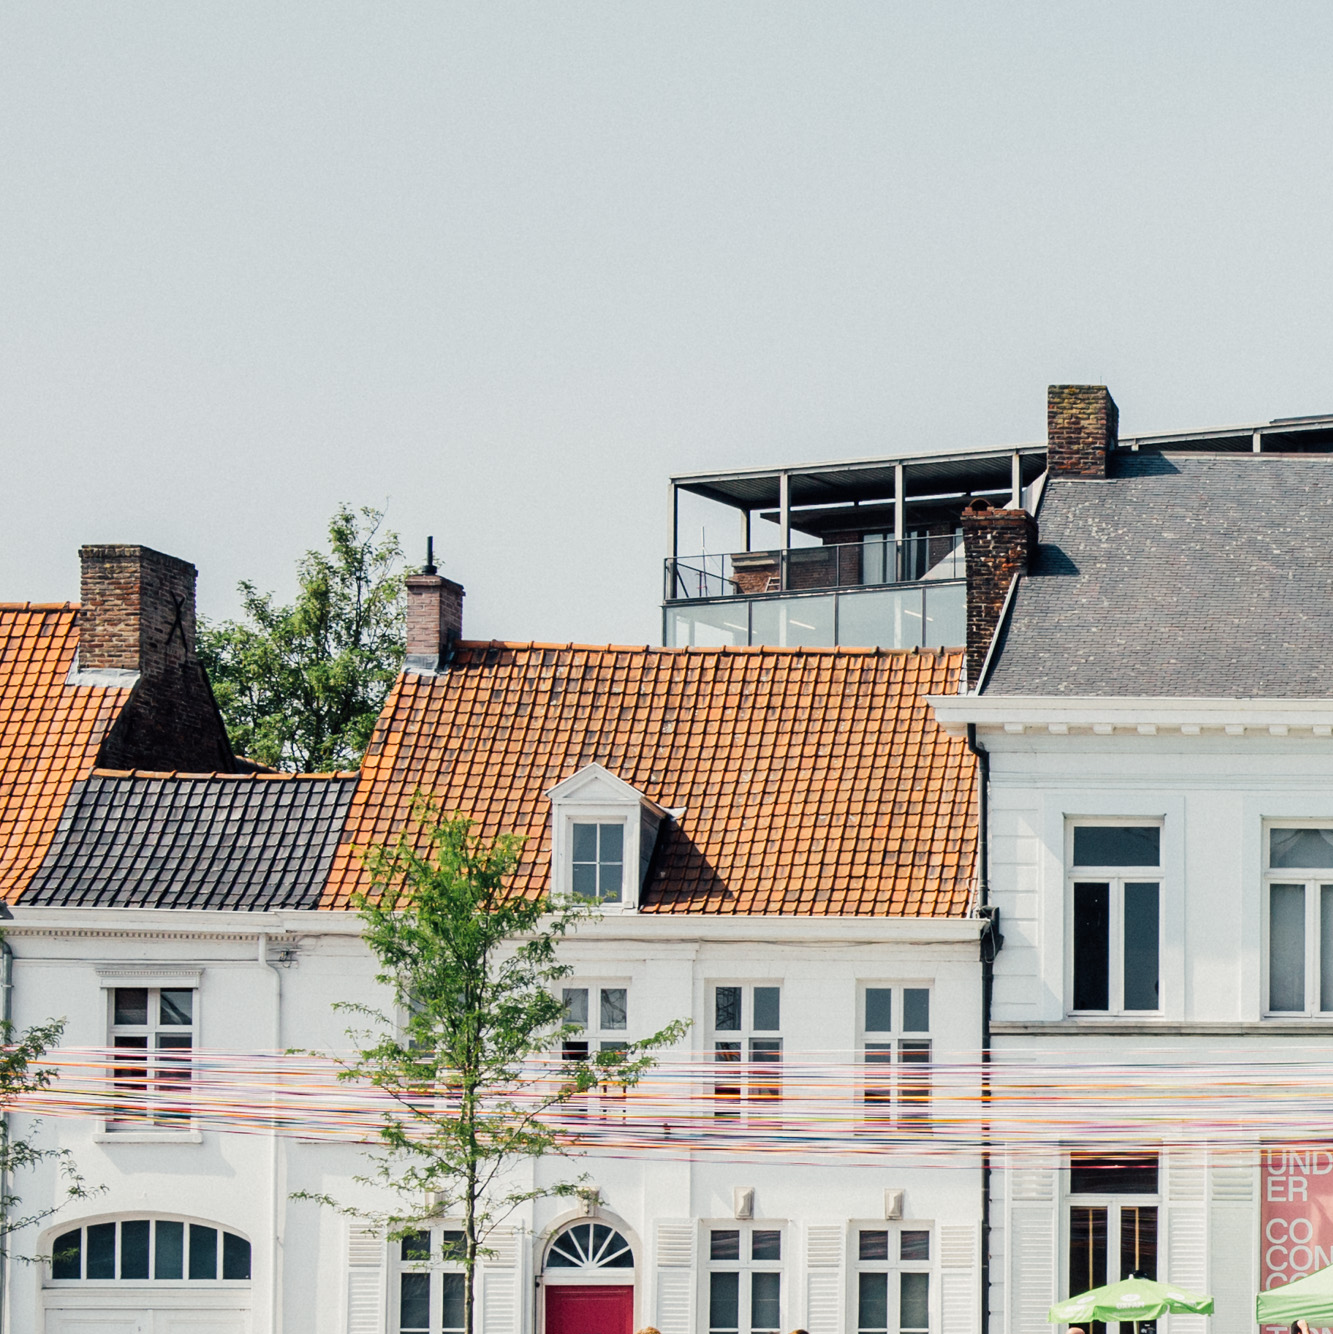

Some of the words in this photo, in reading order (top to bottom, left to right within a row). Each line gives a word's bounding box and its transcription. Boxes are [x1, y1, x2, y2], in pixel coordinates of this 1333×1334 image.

[1267, 1149, 1333, 1175] UND
[1267, 1176, 1308, 1202] ER
[1265, 1218, 1313, 1244] CO
